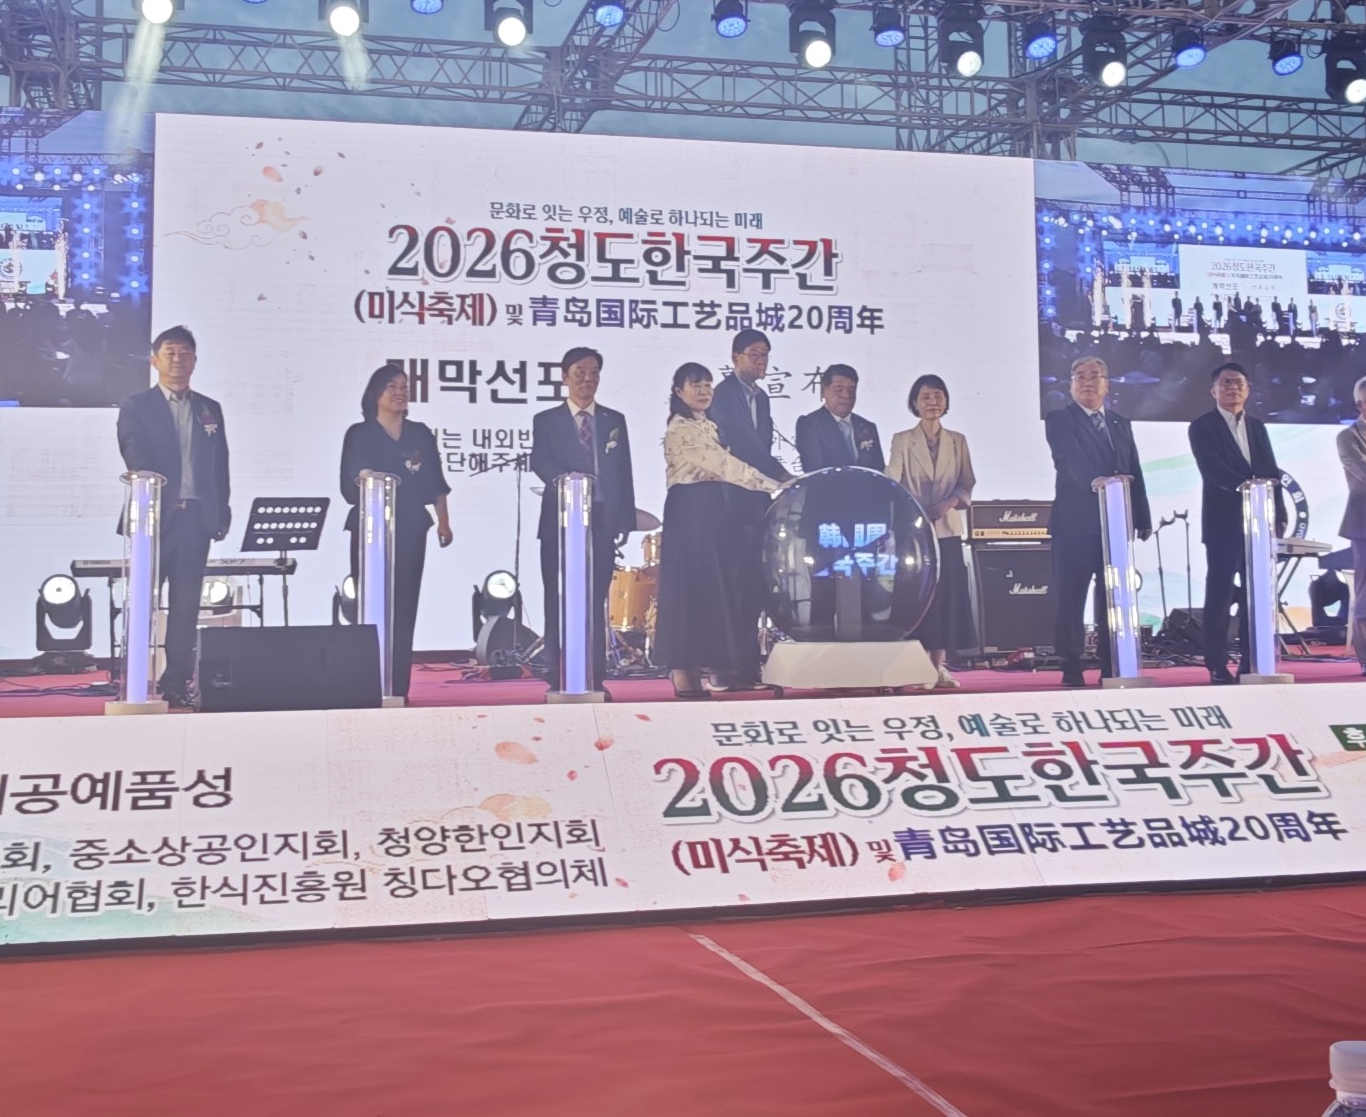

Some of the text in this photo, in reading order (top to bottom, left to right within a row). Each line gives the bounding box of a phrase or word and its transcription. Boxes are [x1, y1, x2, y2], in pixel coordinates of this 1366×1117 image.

[490, 201, 763, 230] 문화로 잇는 우정, 예술로 하나되는 미래
[387, 223, 839, 291] 2026청도한국주간
[353, 290, 885, 336] (미식축제) 및 青岛国际工艺品城20周年
[711, 704, 1233, 747] 문화로 잇는 우정, 예술로 하나되는 미래
[652, 732, 1322, 820] 2026청도한국주간
[68, 828, 361, 871] 중소상공인지회,
[376, 818, 601, 858] 청양한인지회
[671, 809, 1350, 876] (미식축제) 및 青岛国际工艺品城20周年
[171, 869, 368, 910] 한식진흥원
[382, 856, 609, 900] 칭다오협의체
